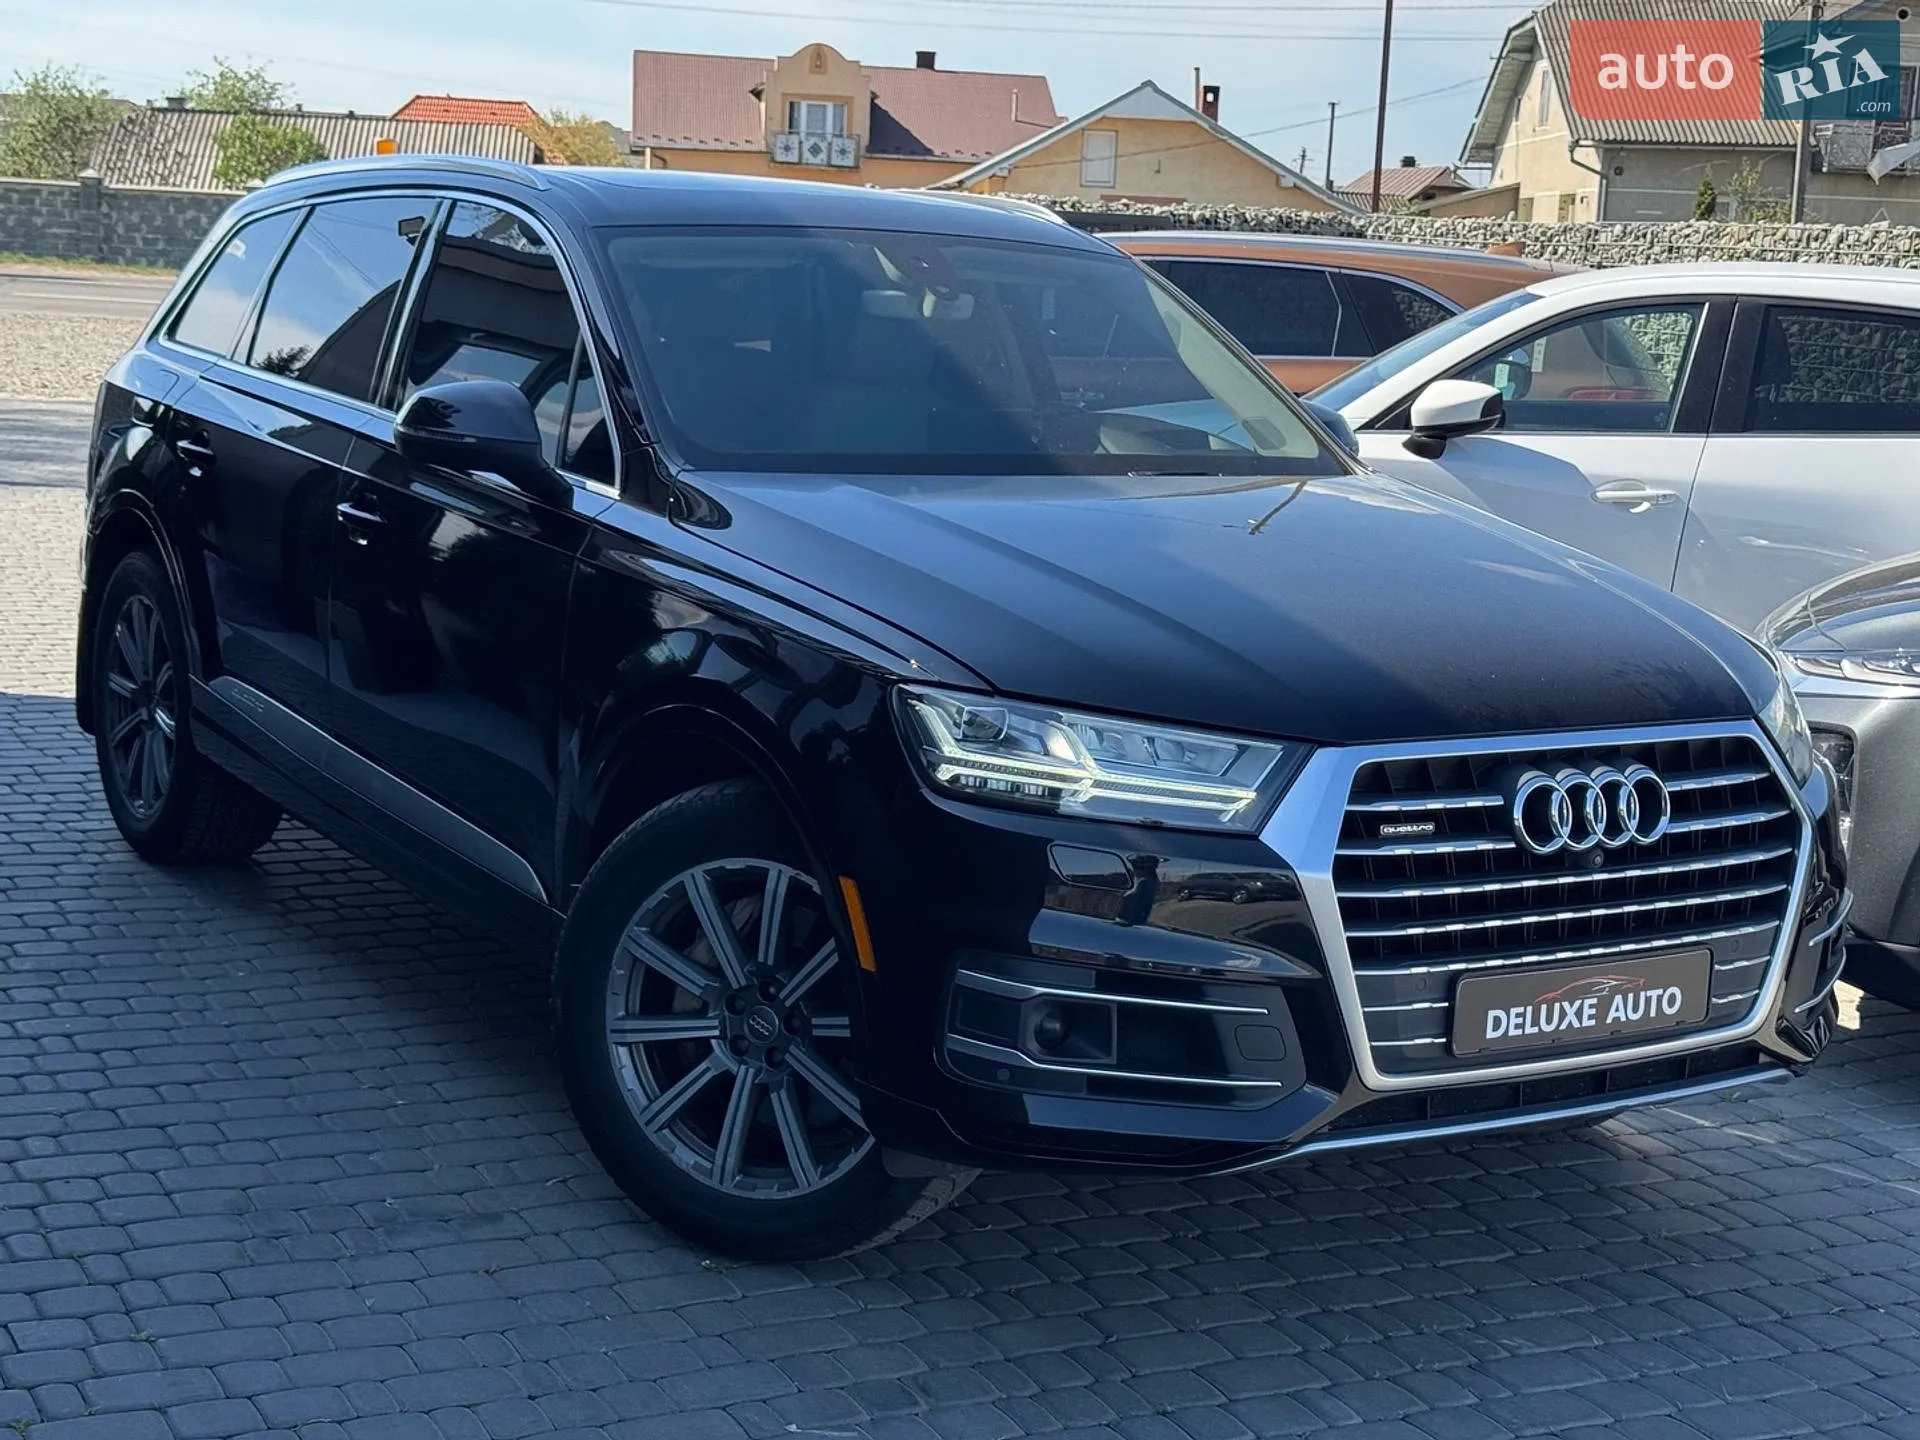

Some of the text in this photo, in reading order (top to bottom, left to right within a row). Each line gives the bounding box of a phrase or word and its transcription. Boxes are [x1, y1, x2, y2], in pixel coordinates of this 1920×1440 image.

[1382, 824, 1434, 834] quattro
[1486, 986, 1682, 1039] DELUXE AUTO
